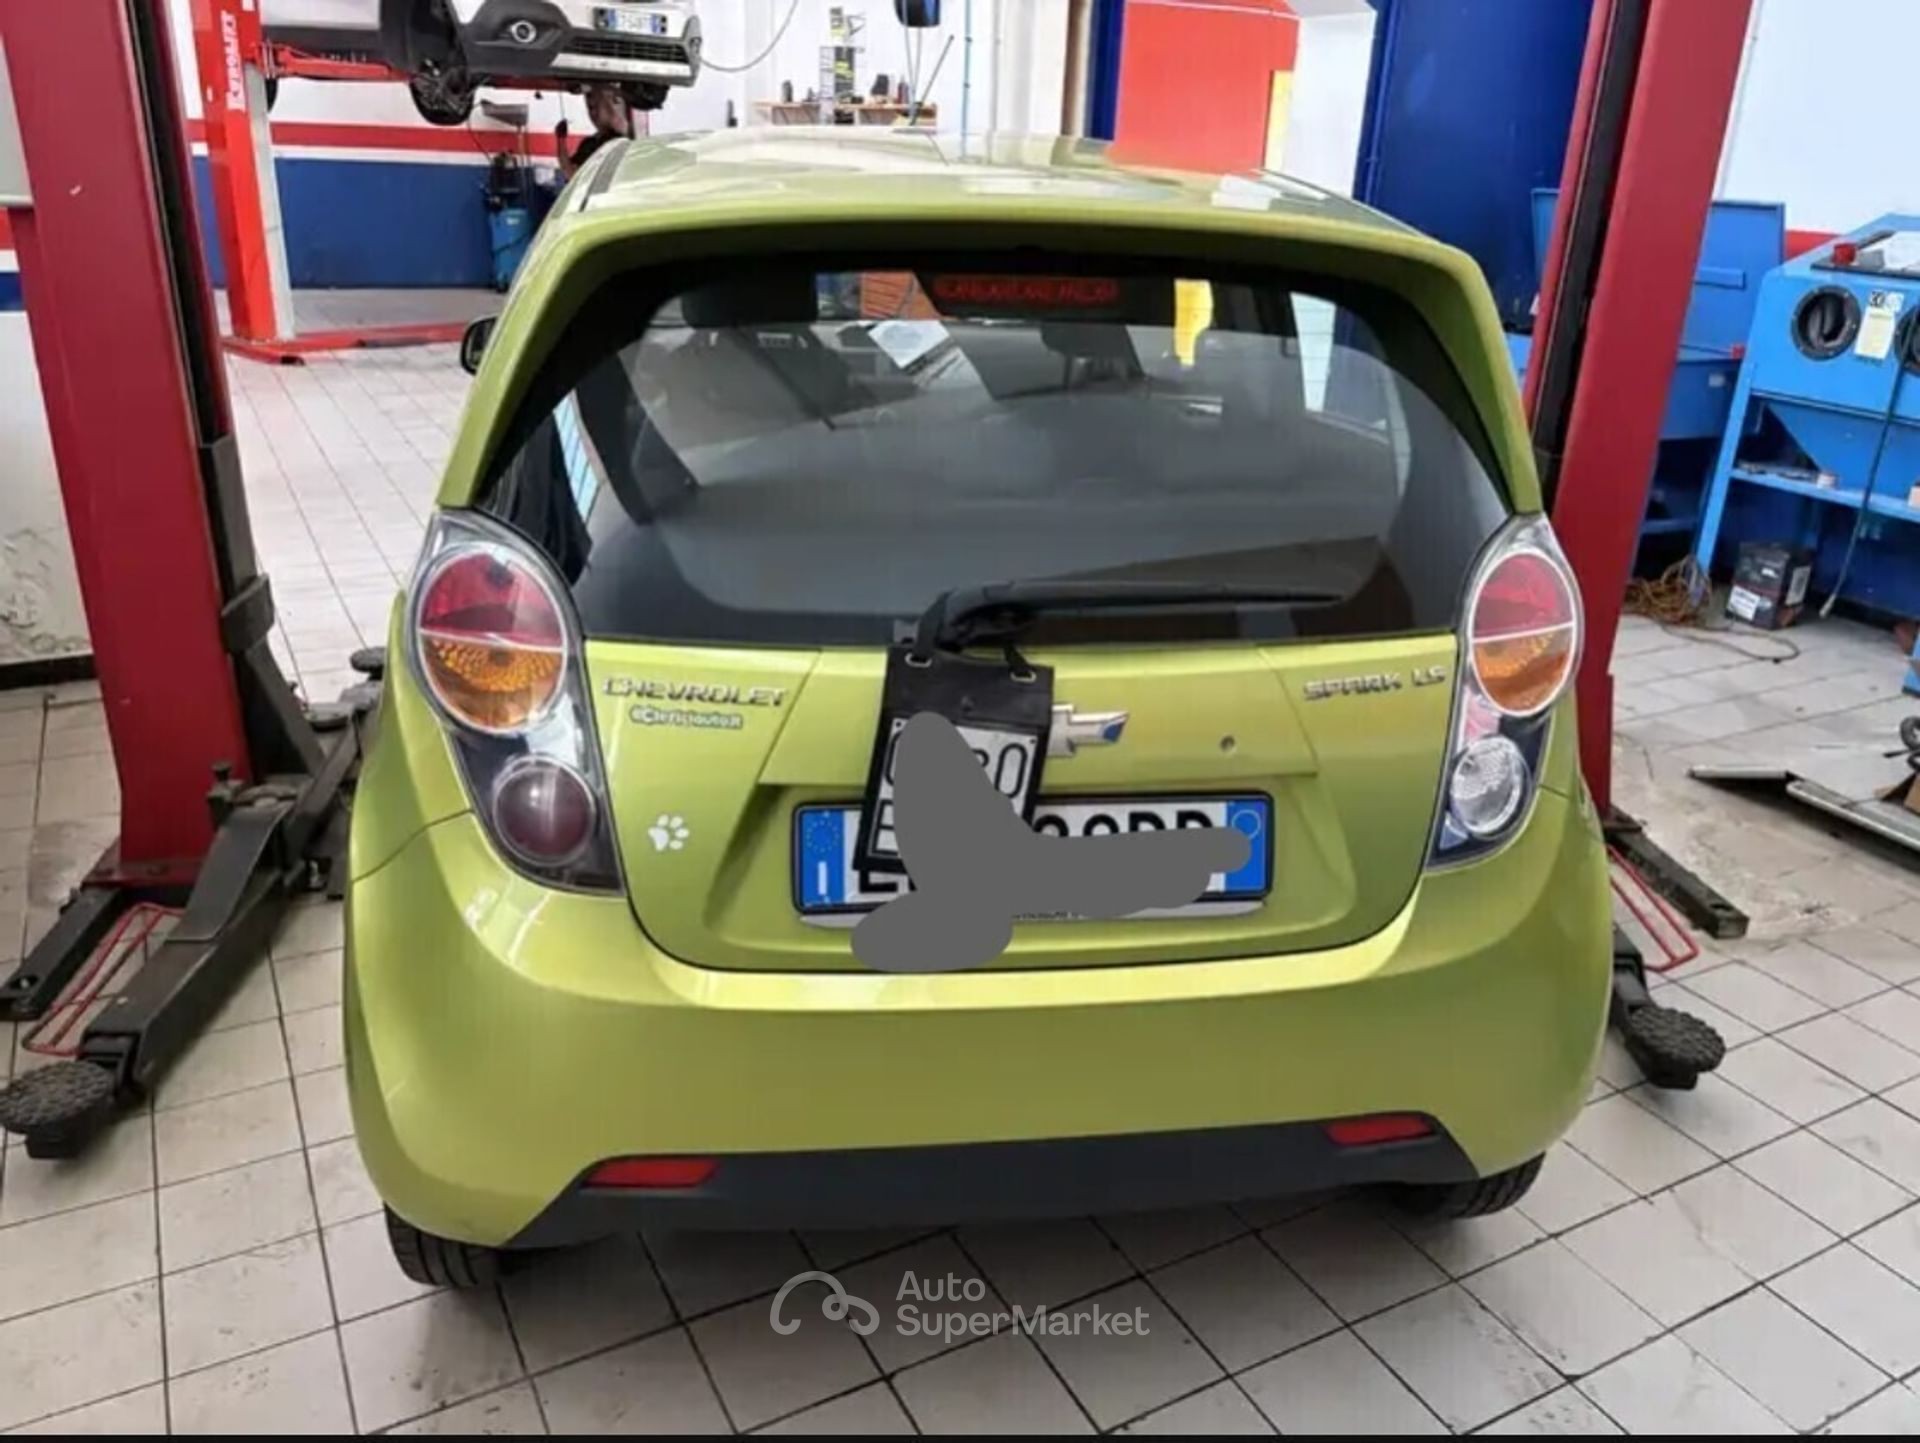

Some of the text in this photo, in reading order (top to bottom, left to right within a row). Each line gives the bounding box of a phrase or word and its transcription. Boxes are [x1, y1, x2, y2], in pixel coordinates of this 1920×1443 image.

[604, 678, 788, 706] CHEVROLET
[1304, 665, 1446, 701] SPARK LS
